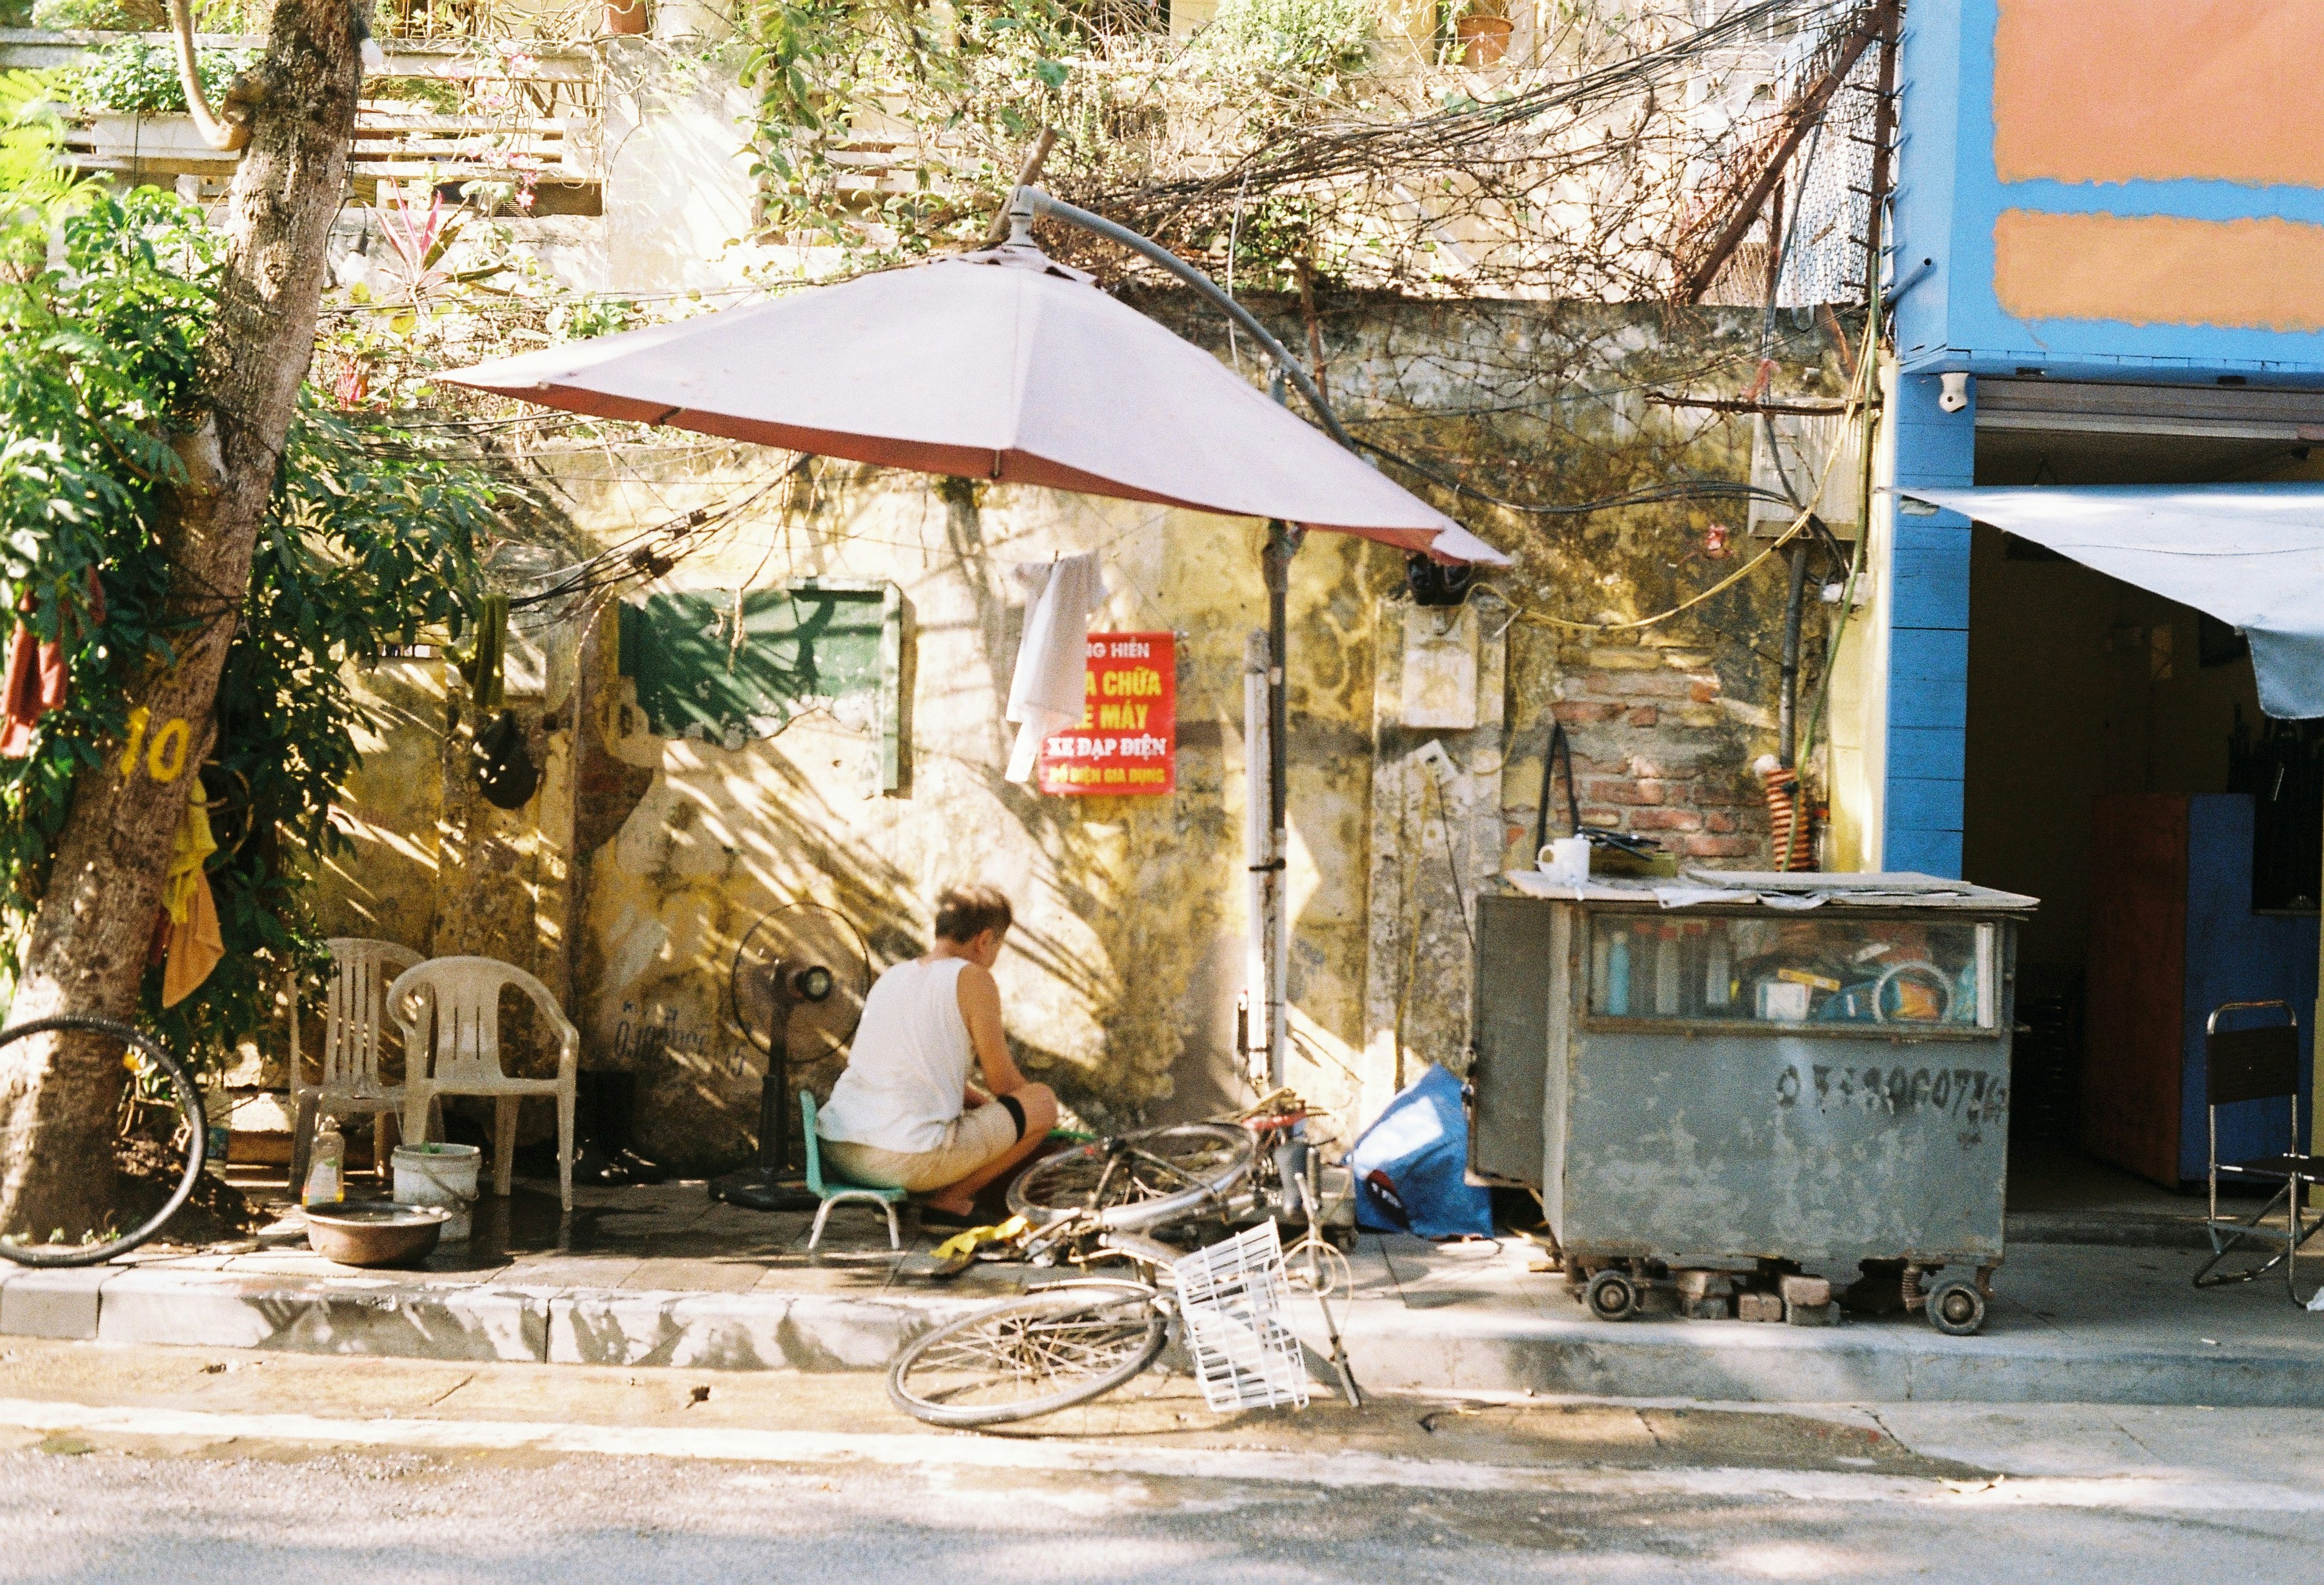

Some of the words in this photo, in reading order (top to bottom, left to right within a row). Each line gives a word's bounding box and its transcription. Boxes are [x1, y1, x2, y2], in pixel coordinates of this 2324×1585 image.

[1103, 666, 1162, 696] CHỮA
[1100, 698, 1148, 730] MÁY
[120, 705, 191, 783] 10
[1047, 738, 1074, 757] XE
[1077, 738, 1117, 761] ĐẠP
[1120, 733, 1167, 761] ĐIỆN
